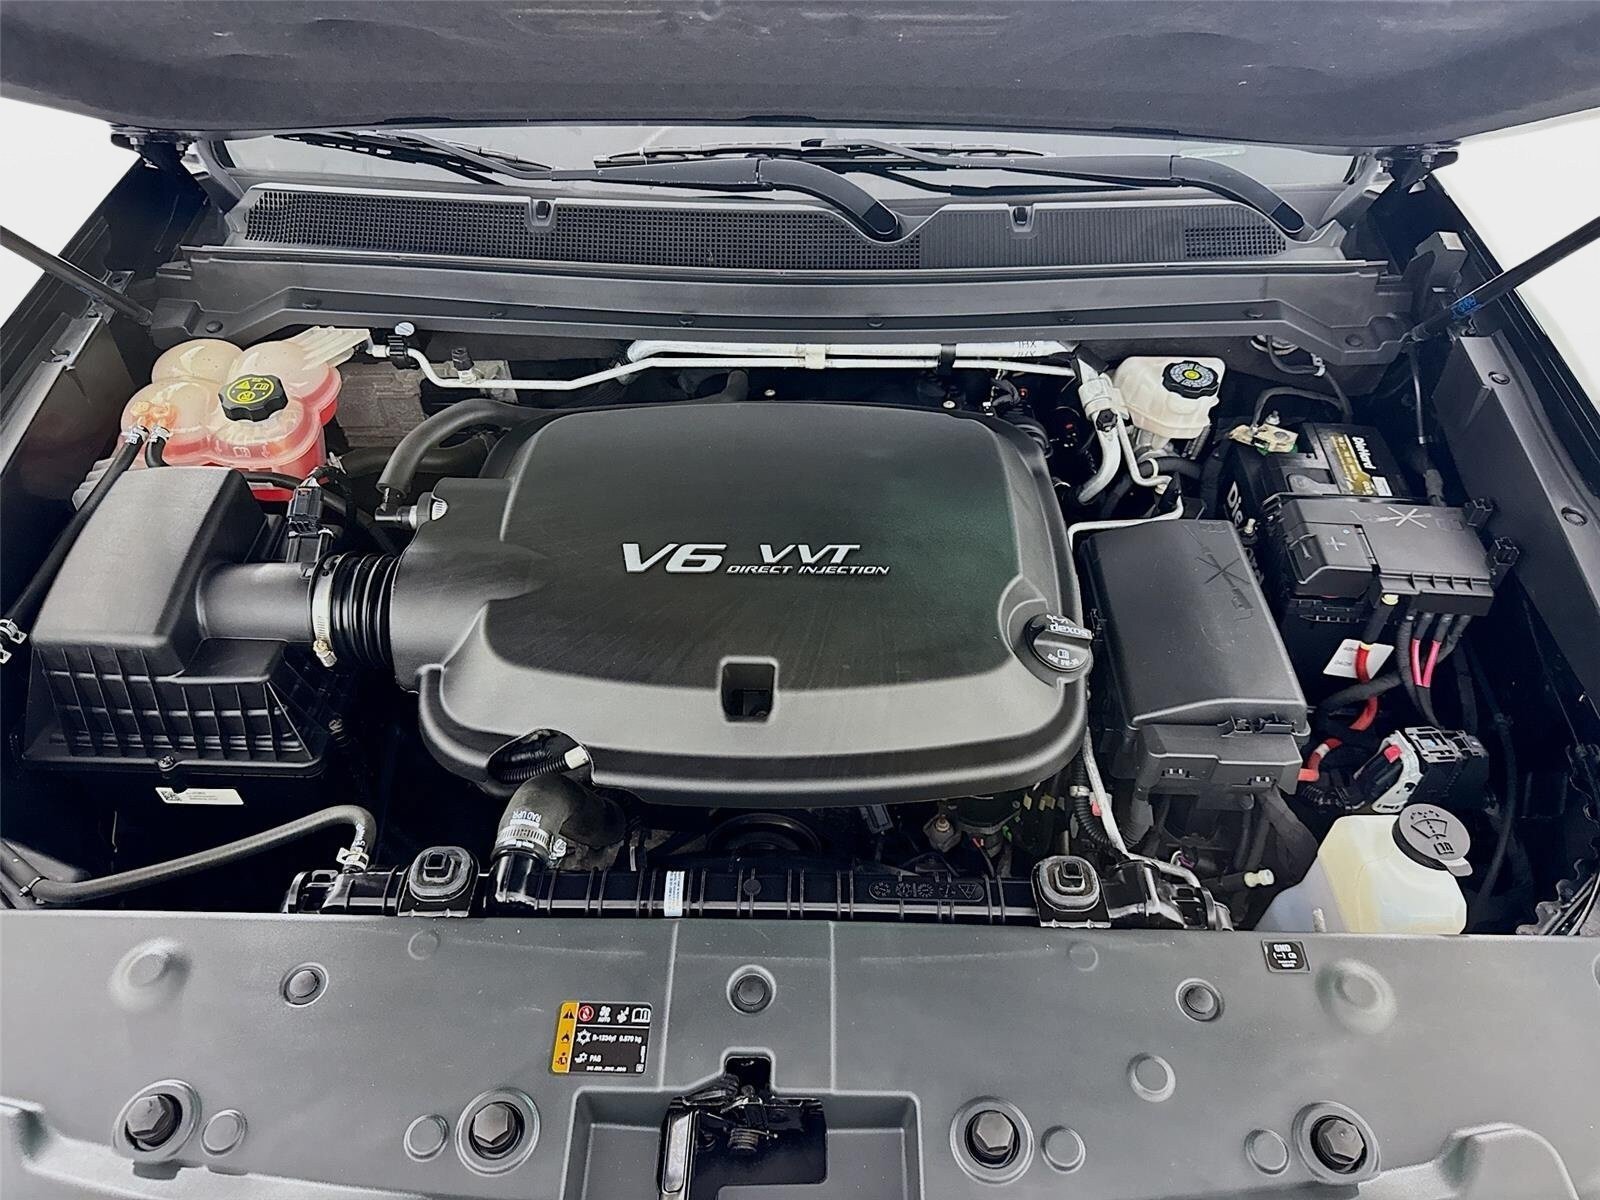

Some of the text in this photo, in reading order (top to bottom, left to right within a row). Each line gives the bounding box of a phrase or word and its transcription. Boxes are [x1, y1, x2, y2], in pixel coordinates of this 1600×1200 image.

[1352, 436, 1377, 469] DieHard
[622, 543, 861, 573] V6 VVT
[726, 565, 890, 575] DIRECT INJECTION
[1050, 622, 1088, 636] dexos
